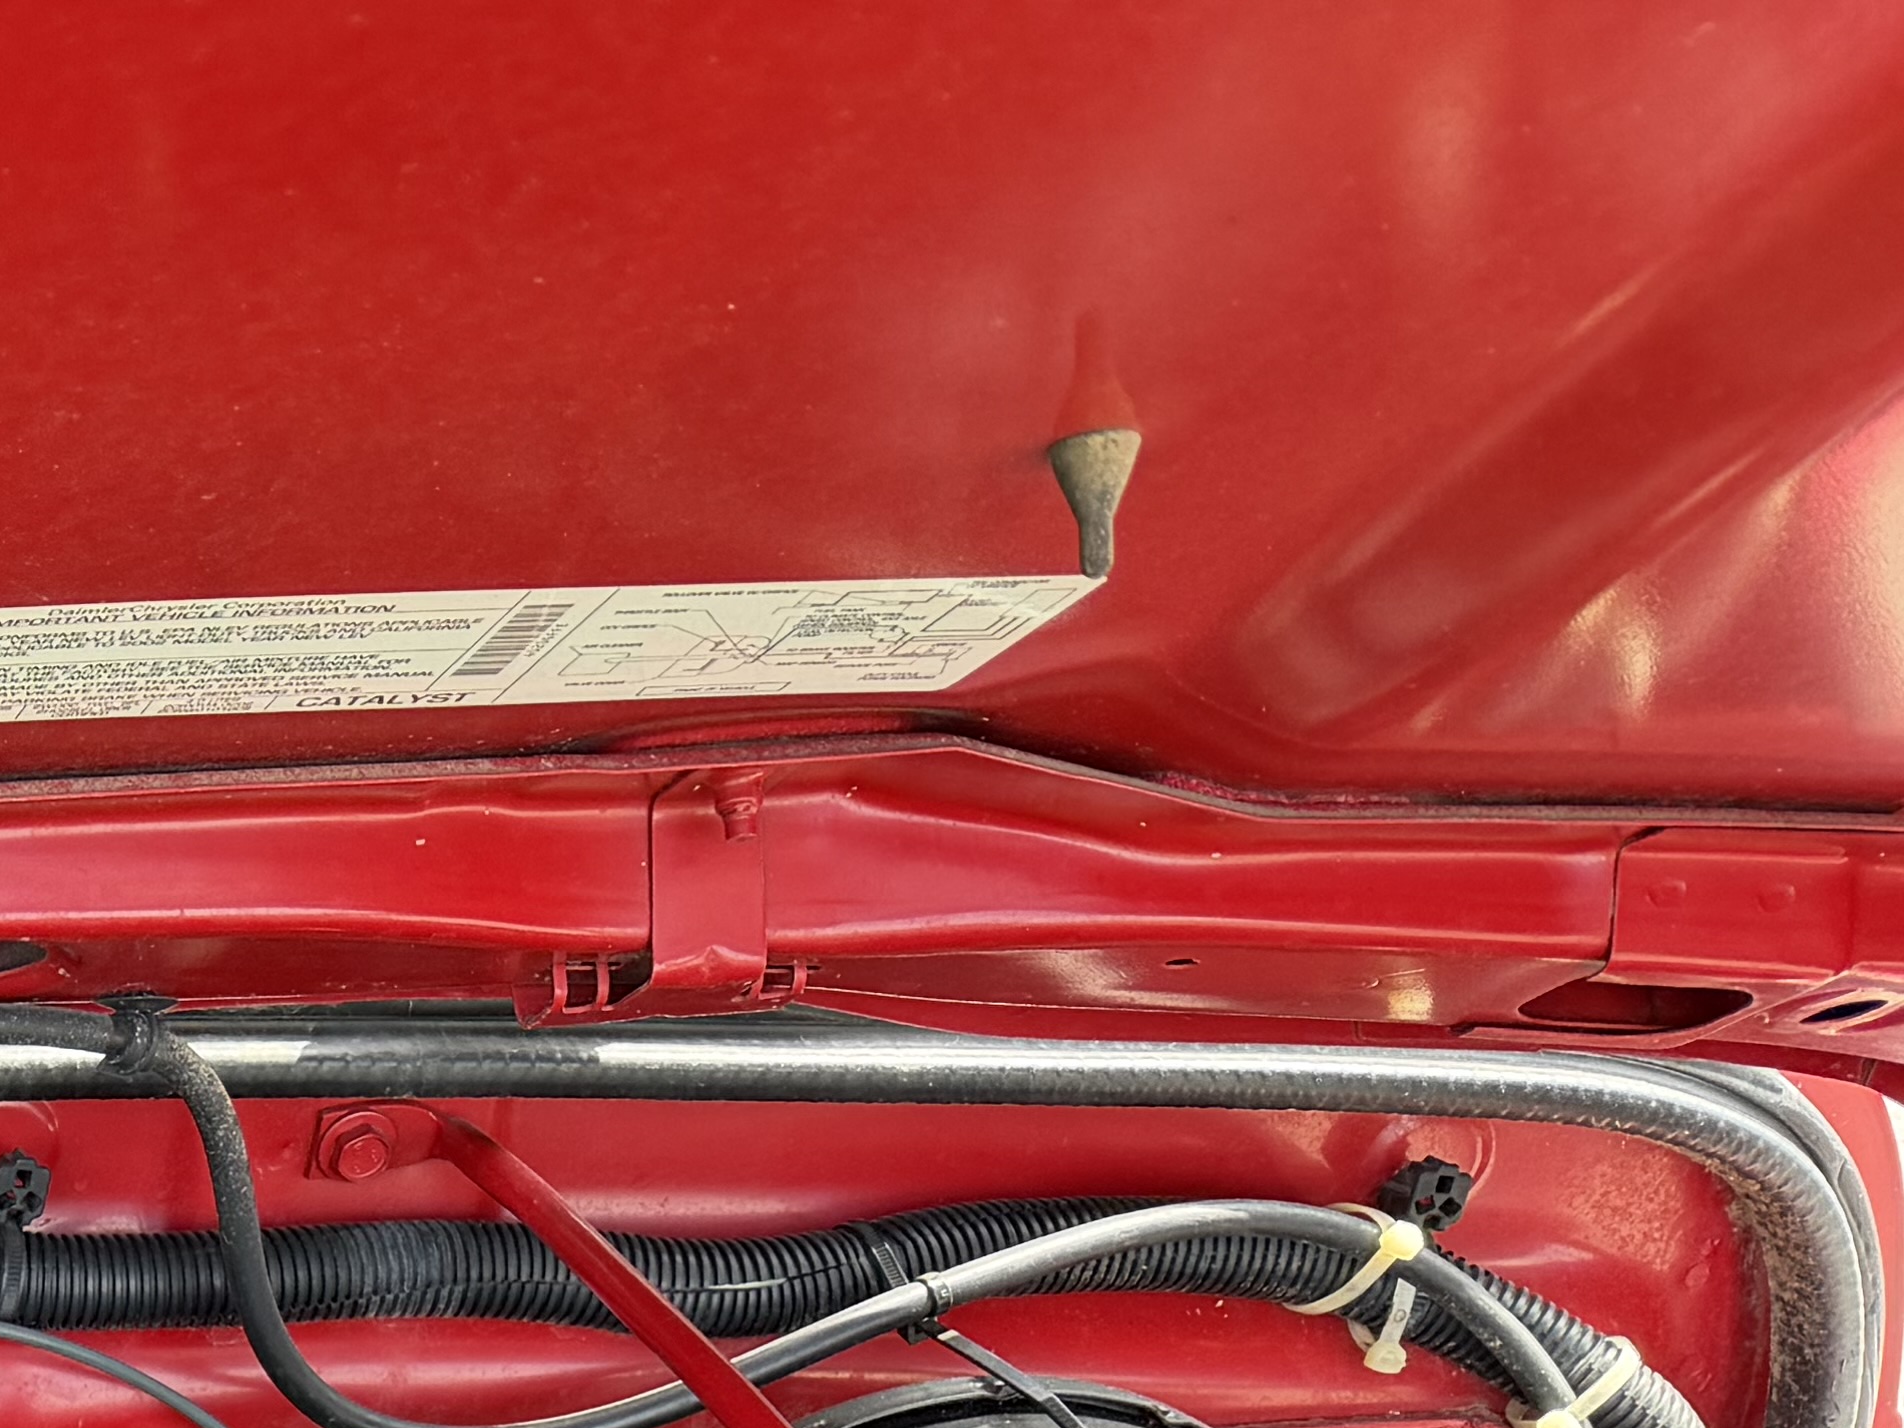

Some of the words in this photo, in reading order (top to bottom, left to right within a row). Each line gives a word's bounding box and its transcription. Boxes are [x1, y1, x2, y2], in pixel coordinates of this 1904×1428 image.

[45, 602, 217, 616] DaimlerChrysler
[218, 596, 351, 610] Corporation
[125, 610, 232, 622] VEHICLE
[228, 603, 399, 618] INFORMATION
[249, 620, 377, 631] REGULATIONS
[377, 616, 488, 627] APPLICABLE
[367, 622, 476, 633] CALIFORNIA
[360, 669, 439, 679] MANUAL
[290, 690, 479, 708] CATALYST
